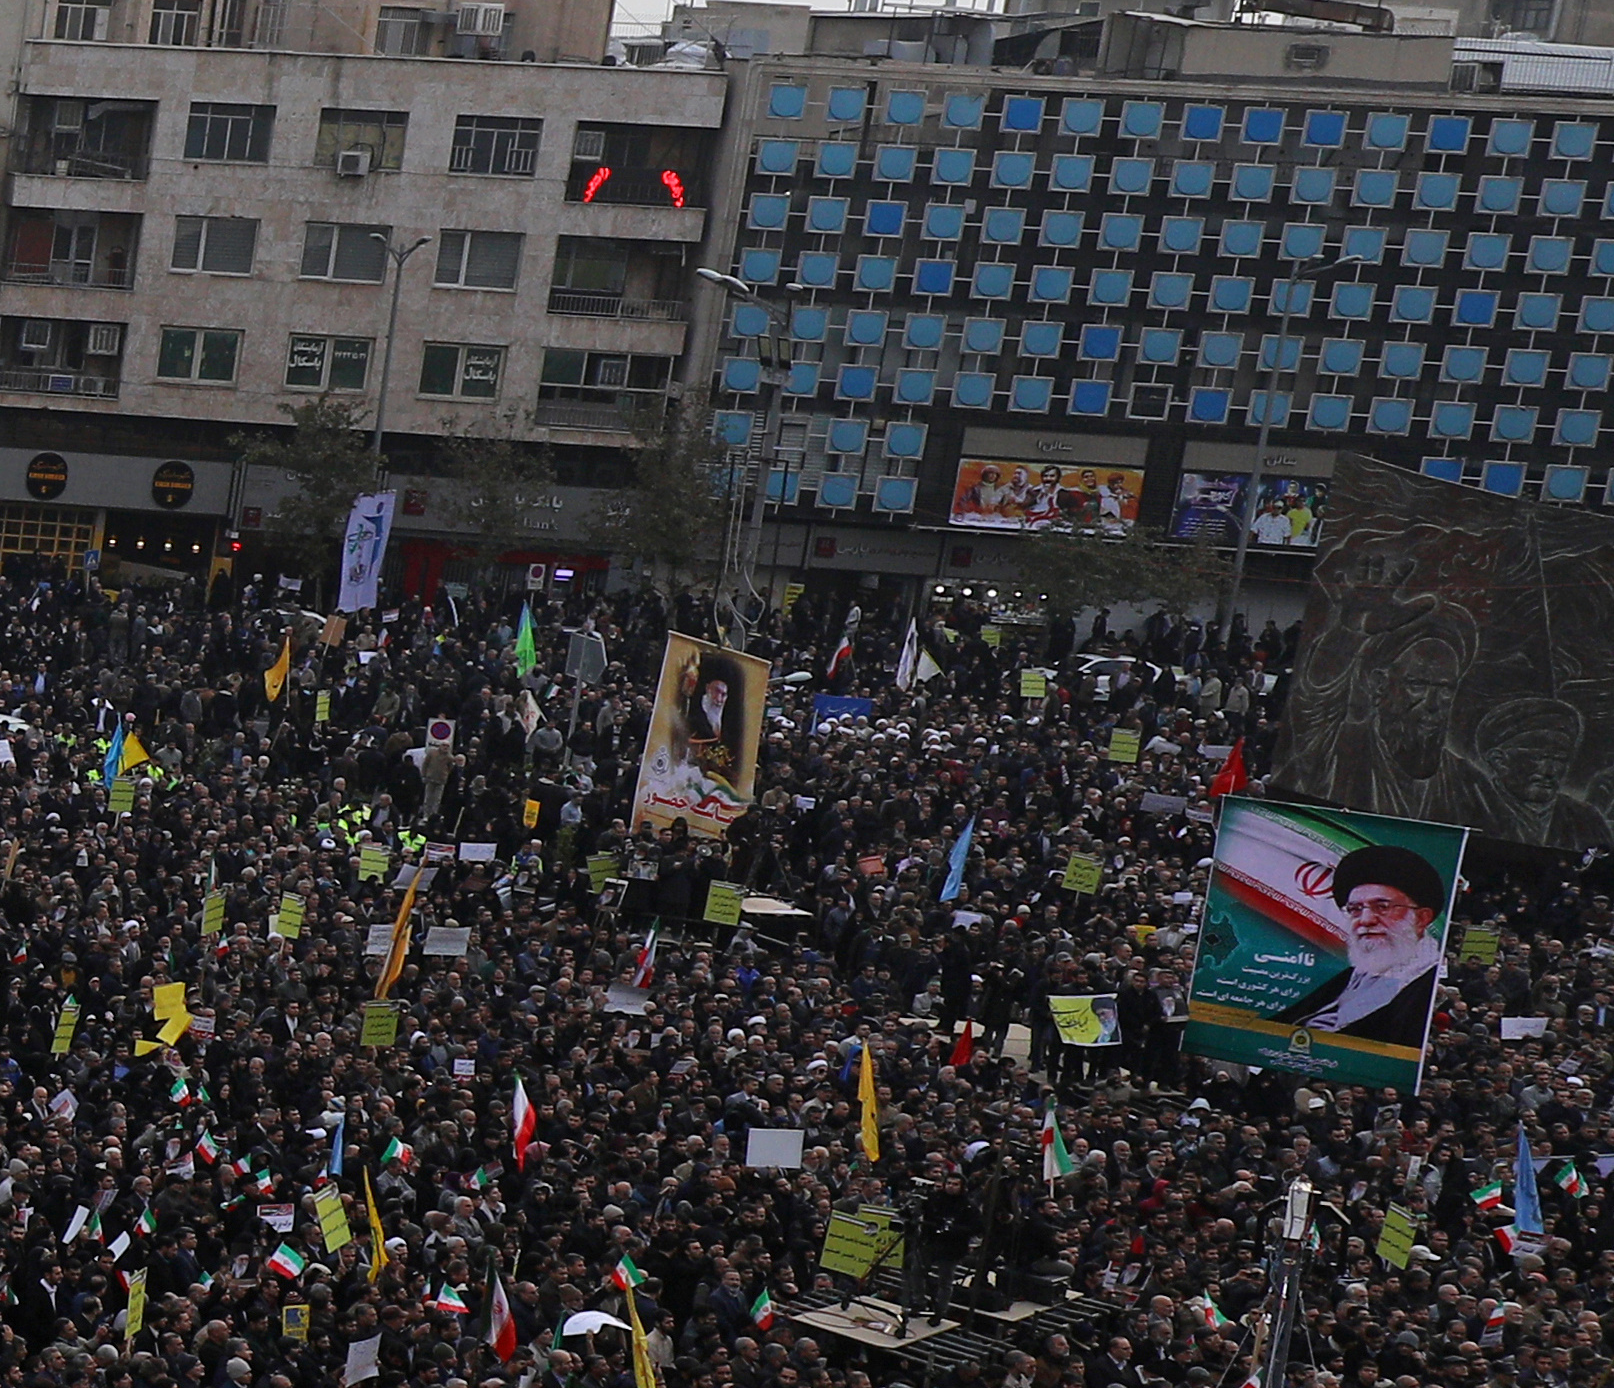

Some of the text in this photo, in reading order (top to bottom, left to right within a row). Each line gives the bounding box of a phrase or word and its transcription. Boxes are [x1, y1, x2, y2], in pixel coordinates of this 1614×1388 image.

[1238, 982, 1269, 992] کشوری
[1269, 986, 1280, 995] هر
[1217, 992, 1229, 1002] ای
[1280, 988, 1301, 998] برای
[1230, 994, 1254, 1005] جامعه
[1255, 999, 1266, 1008] هر
[1266, 1002, 1287, 1013] برای
